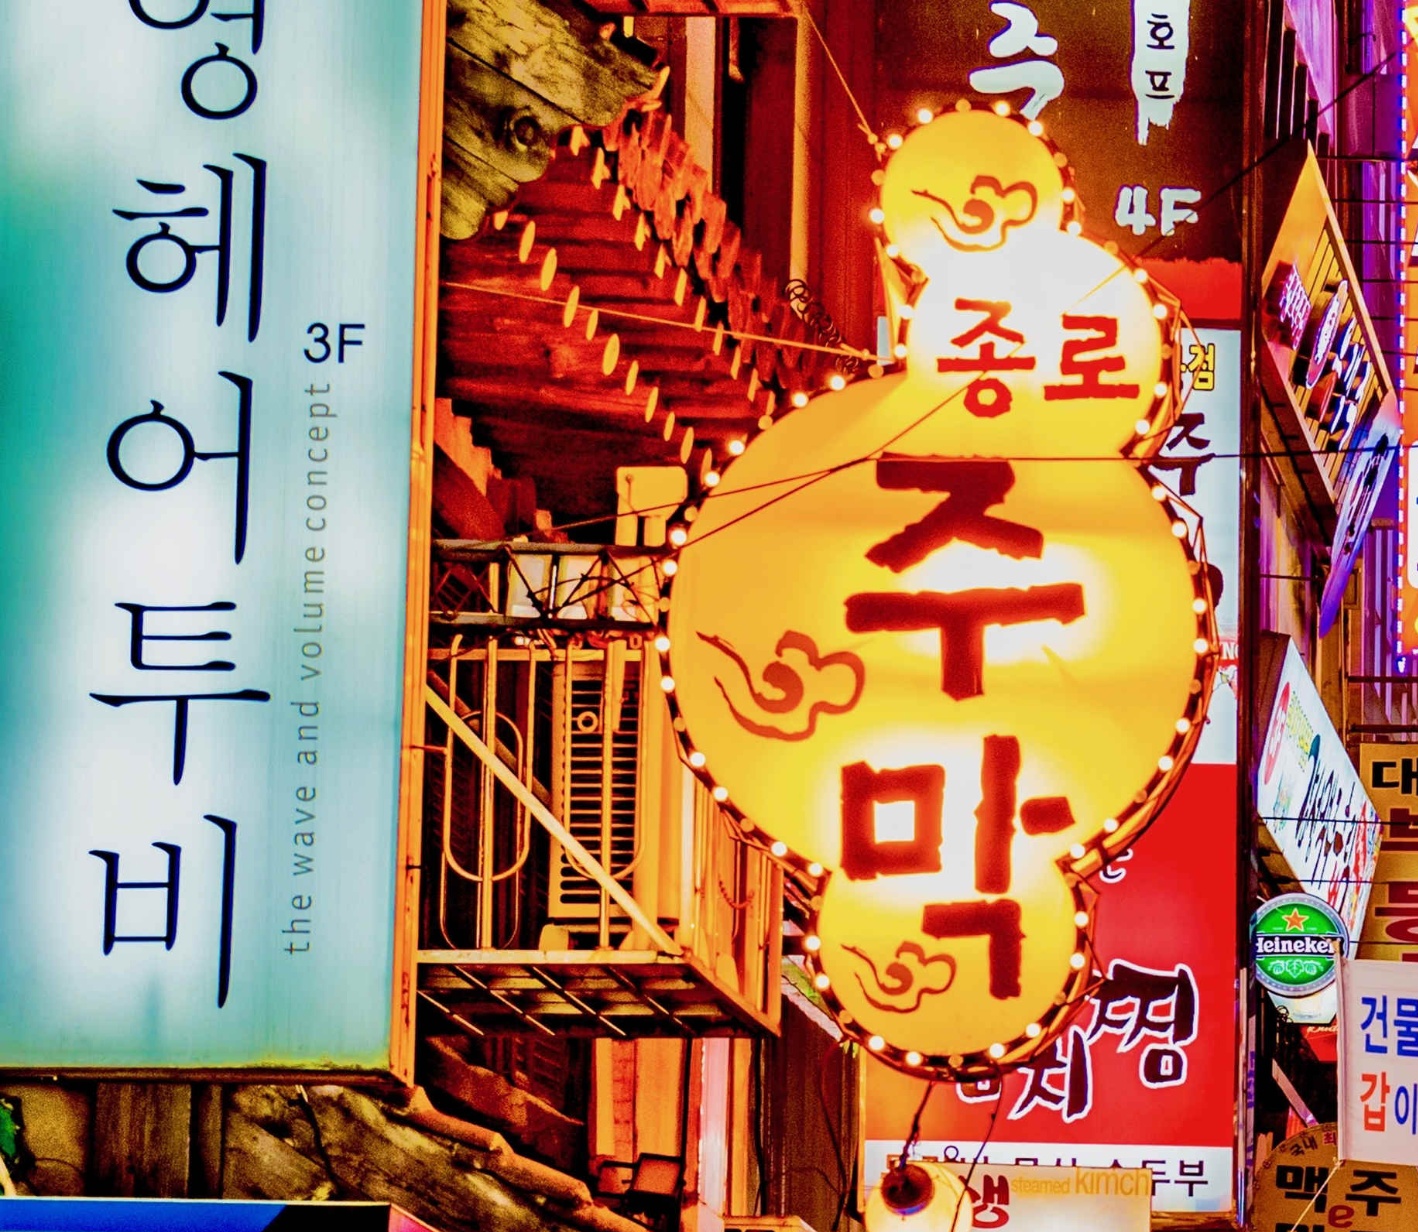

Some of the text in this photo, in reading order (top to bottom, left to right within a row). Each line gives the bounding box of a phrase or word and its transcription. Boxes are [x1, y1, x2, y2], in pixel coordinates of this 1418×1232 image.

[1114, 186, 1201, 235] 4F
[303, 322, 366, 364] 3F
[937, 298, 1139, 418] 종로
[283, 381, 338, 954] the wave and volume concept
[840, 459, 1086, 1001] 주막
[1360, 1072, 1418, 1135] 갑이
[1011, 1177, 1071, 1195] steamed
[1276, 1165, 1402, 1218] 맥주
